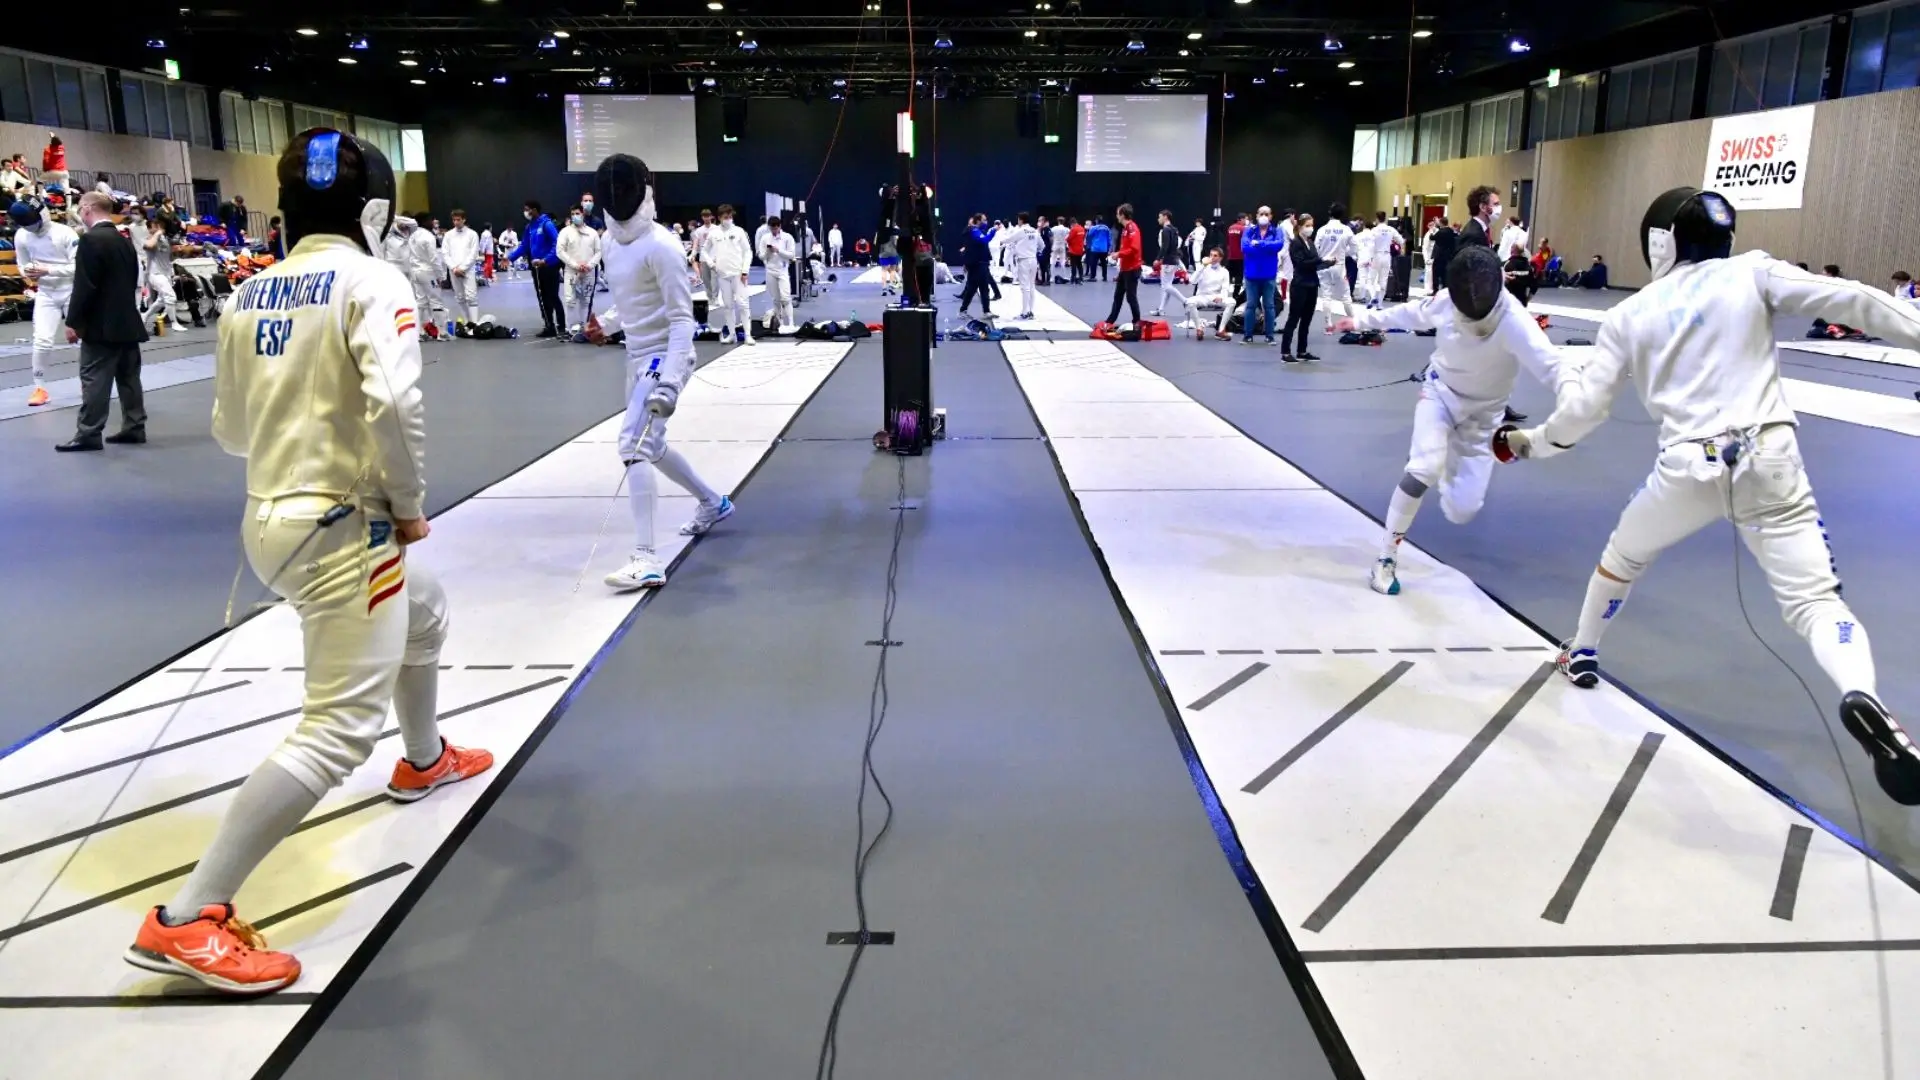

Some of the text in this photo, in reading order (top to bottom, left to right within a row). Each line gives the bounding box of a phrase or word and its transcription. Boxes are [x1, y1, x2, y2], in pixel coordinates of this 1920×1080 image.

[1720, 134, 1776, 162] SWISS
[1714, 160, 1797, 188] FENCING
[255, 318, 293, 357] ESP
